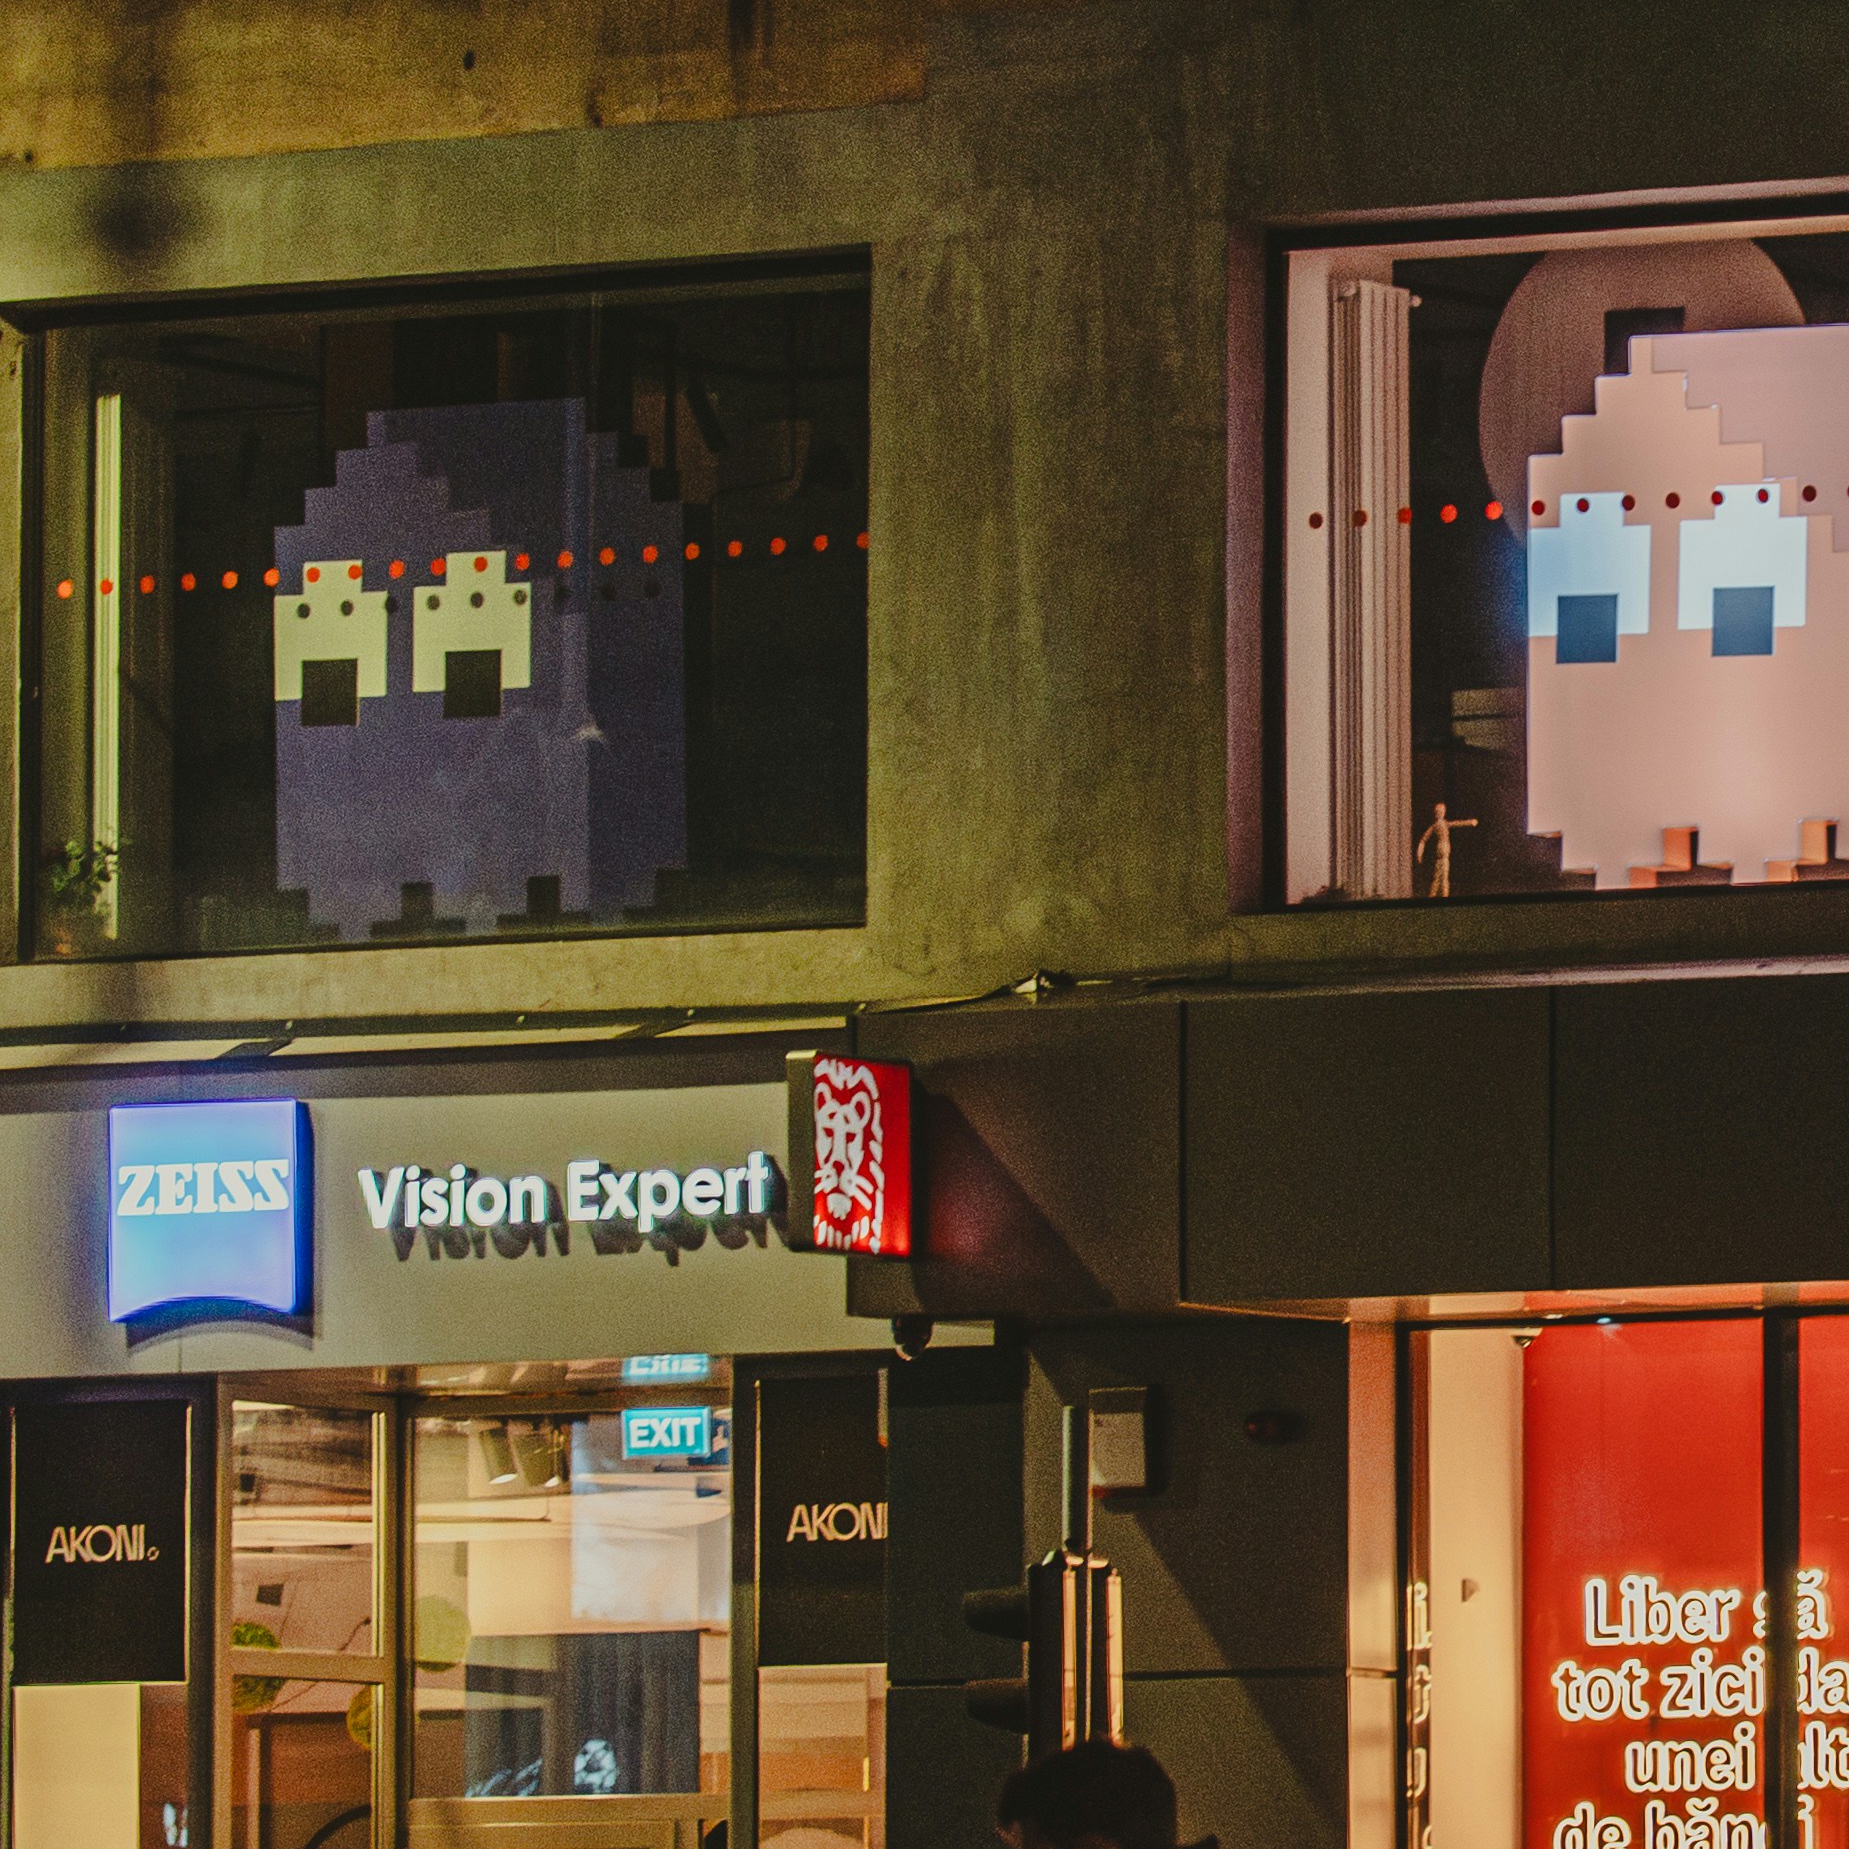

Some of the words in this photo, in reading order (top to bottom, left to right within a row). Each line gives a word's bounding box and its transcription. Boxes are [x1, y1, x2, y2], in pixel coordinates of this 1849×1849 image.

[117, 1159, 289, 1216] ZEISS
[358, 1164, 548, 1228] Vision
[567, 1151, 769, 1233] Expert
[629, 1417, 702, 1449] EXIT
[1585, 1575, 1740, 1646] Liber
[1552, 1659, 1650, 1721] tot
[1660, 1646, 1766, 1718] zici
[1625, 1721, 1756, 1792] unei
